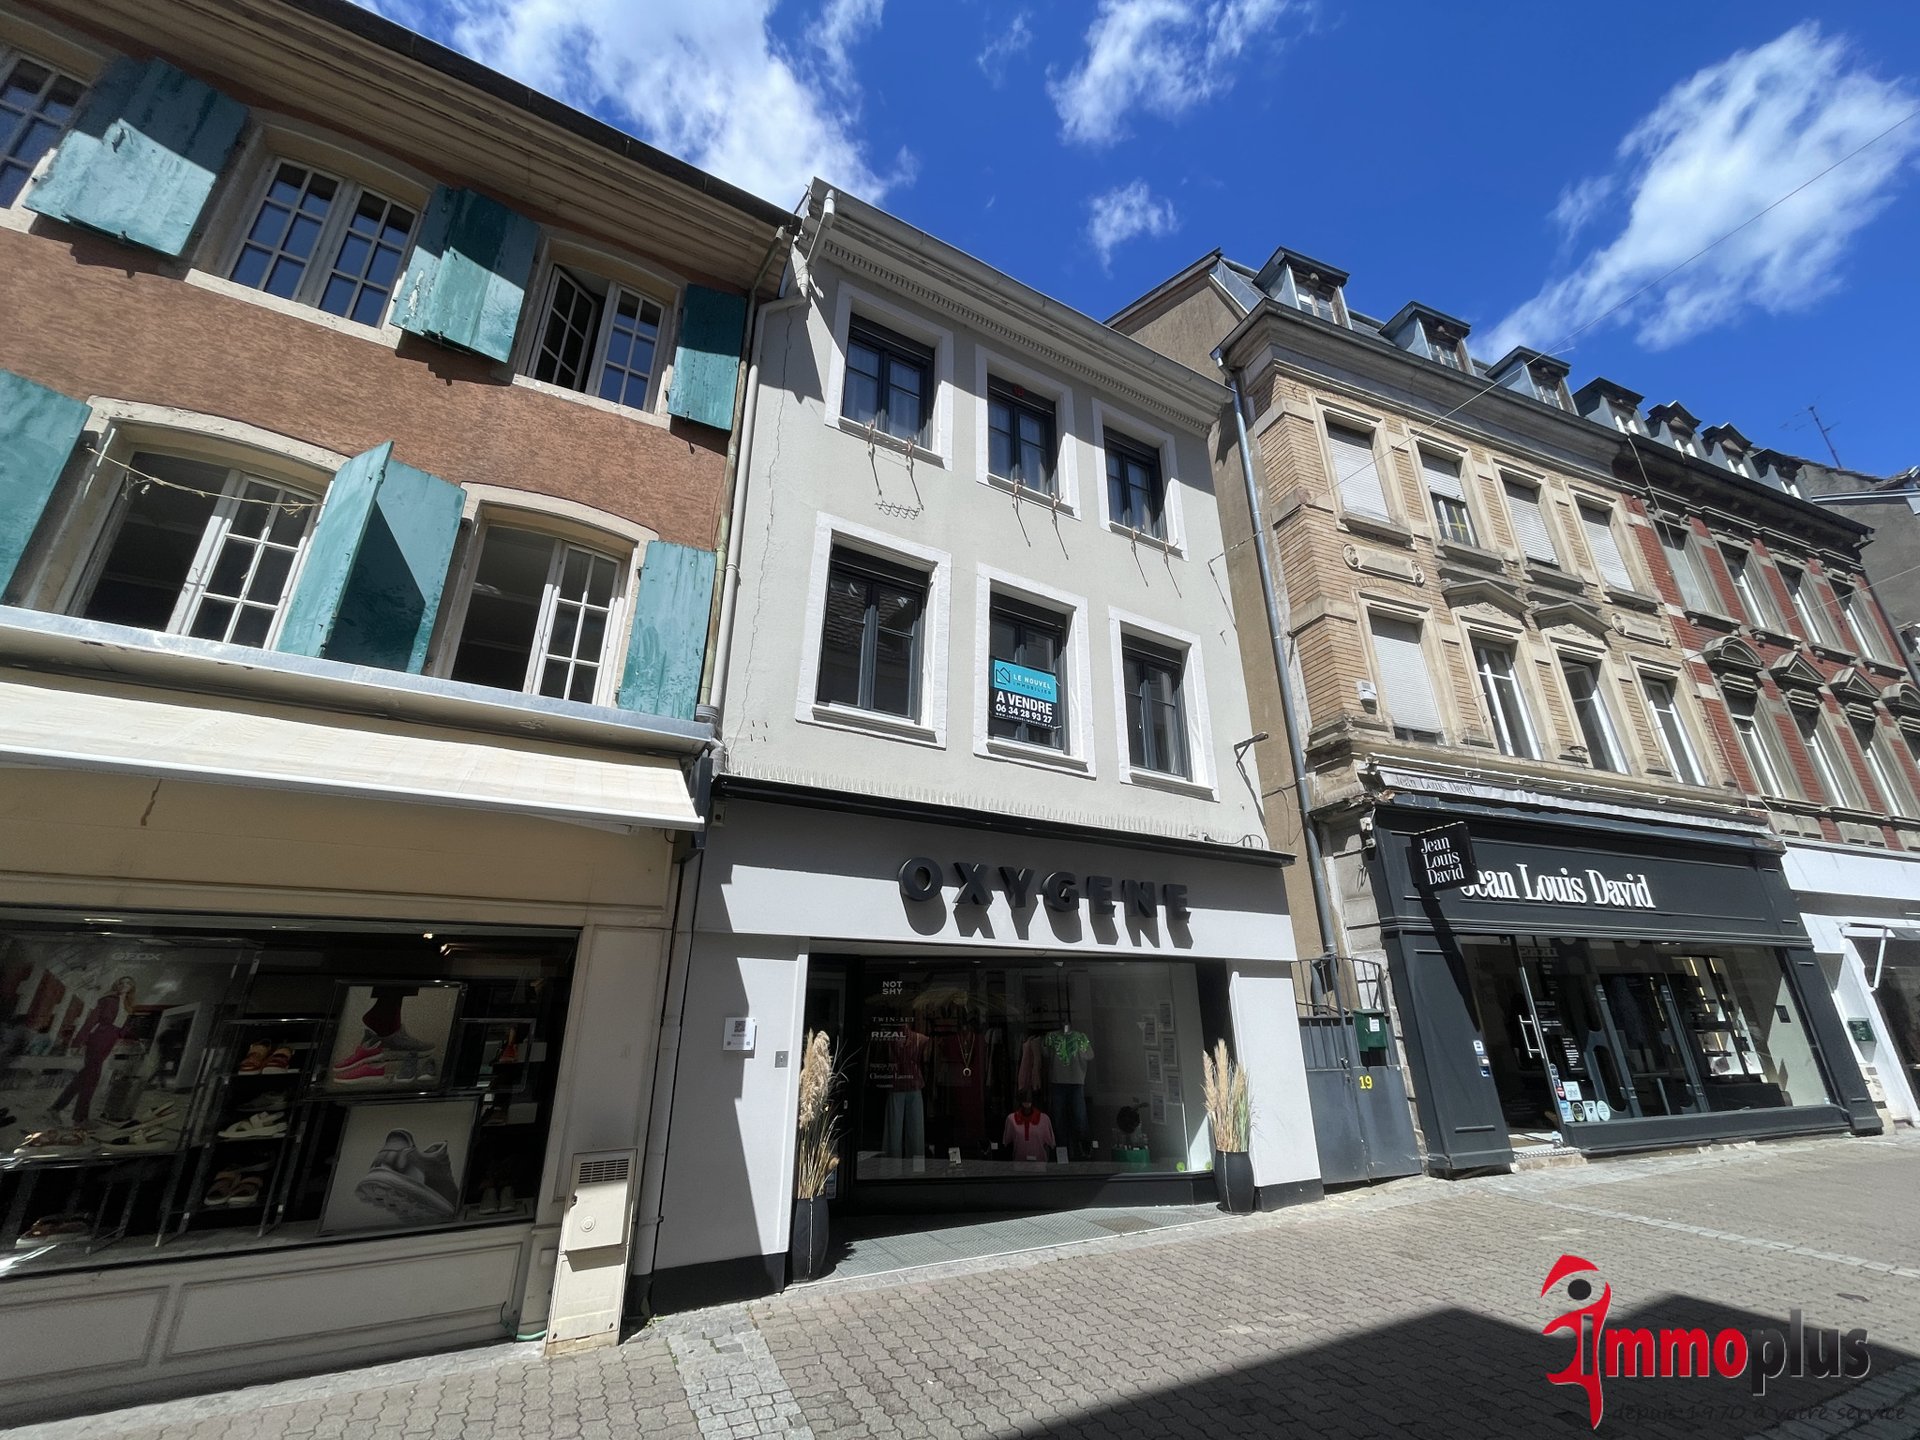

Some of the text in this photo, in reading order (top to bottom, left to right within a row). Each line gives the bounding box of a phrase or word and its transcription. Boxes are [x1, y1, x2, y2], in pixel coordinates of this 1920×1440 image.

[1013, 674, 1051, 689] LE NOUVEL
[996, 691, 1053, 715] A VENDRE
[996, 704, 1053, 724] 06 34 28 93 27
[1395, 775, 1476, 795] Jean Louis David
[1420, 836, 1451, 854] Jean
[1423, 849, 1461, 870] Louis
[1426, 863, 1465, 885] David
[898, 857, 1192, 922] OXYGENE
[1516, 863, 1588, 904] Louis
[1585, 869, 1657, 909] David
[882, 980, 903, 988] NOT
[1359, 1075, 1373, 1090] 19
